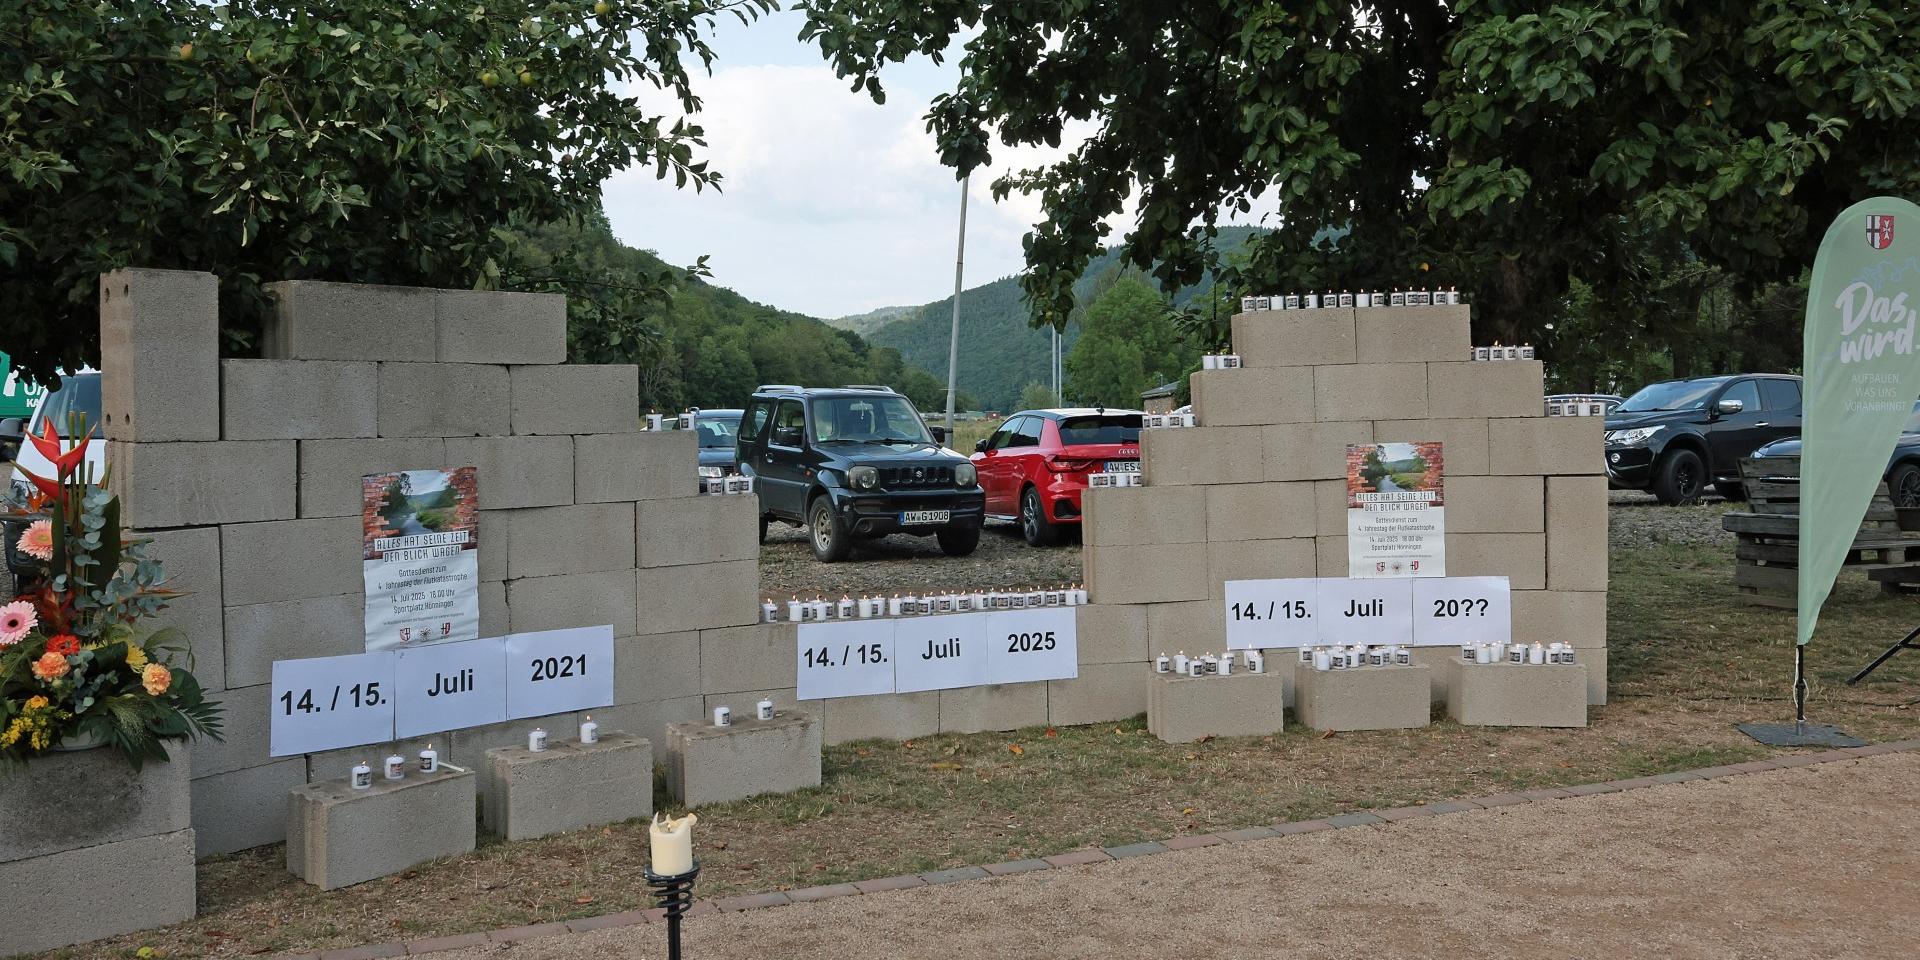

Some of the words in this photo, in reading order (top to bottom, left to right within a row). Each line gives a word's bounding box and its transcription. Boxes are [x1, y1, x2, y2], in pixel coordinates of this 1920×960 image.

[1834, 281, 1909, 335] Das
[1855, 388, 1876, 397] WAS
[1878, 387, 1897, 397] UNS
[1845, 401, 1905, 412] VORANBRINGT
[1109, 462, 1120, 472] AW
[1357, 493, 1378, 502] ALLES
[1380, 493, 1394, 501] HAT
[1397, 492, 1416, 501] SEINE
[1420, 492, 1434, 500] ZEIT
[1364, 504, 1378, 512] DEN
[1380, 503, 1400, 511] BLICK
[1403, 502, 1428, 511] WAGEN
[905, 512, 917, 522] AW
[376, 537, 401, 550] ALLES
[404, 535, 420, 547] HAT
[423, 533, 446, 545] SEINE
[450, 531, 467, 543] ZEIT
[384, 551, 400, 563] DEN
[403, 549, 429, 561] BLICK
[432, 545, 460, 558] WAGEN
[398, 566, 435, 578] Gottesdienst
[435, 565, 447, 573] zum
[385, 579, 413, 591] Jahrestag
[413, 577, 423, 587] der
[423, 573, 468, 586] Flutkatastrophe
[400, 593, 410, 603] Juli
[411, 591, 426, 601] 2025
[445, 588, 456, 597] Uhr
[393, 602, 424, 615] Sportplatz
[1231, 601, 1262, 621] 14.
[1268, 601, 1275, 620] /
[1282, 600, 1312, 619] 15.
[1344, 598, 1384, 617] Juli
[1433, 598, 1489, 617] 20??
[804, 647, 835, 668] 14.
[842, 645, 850, 666] /
[857, 643, 888, 664] 15.
[921, 638, 961, 660] Juli
[1007, 631, 1056, 653] 2025
[280, 688, 322, 716] 14.
[330, 685, 341, 711] /
[349, 682, 387, 708] 15.
[427, 668, 474, 697] Juli
[530, 653, 587, 682] 2021
